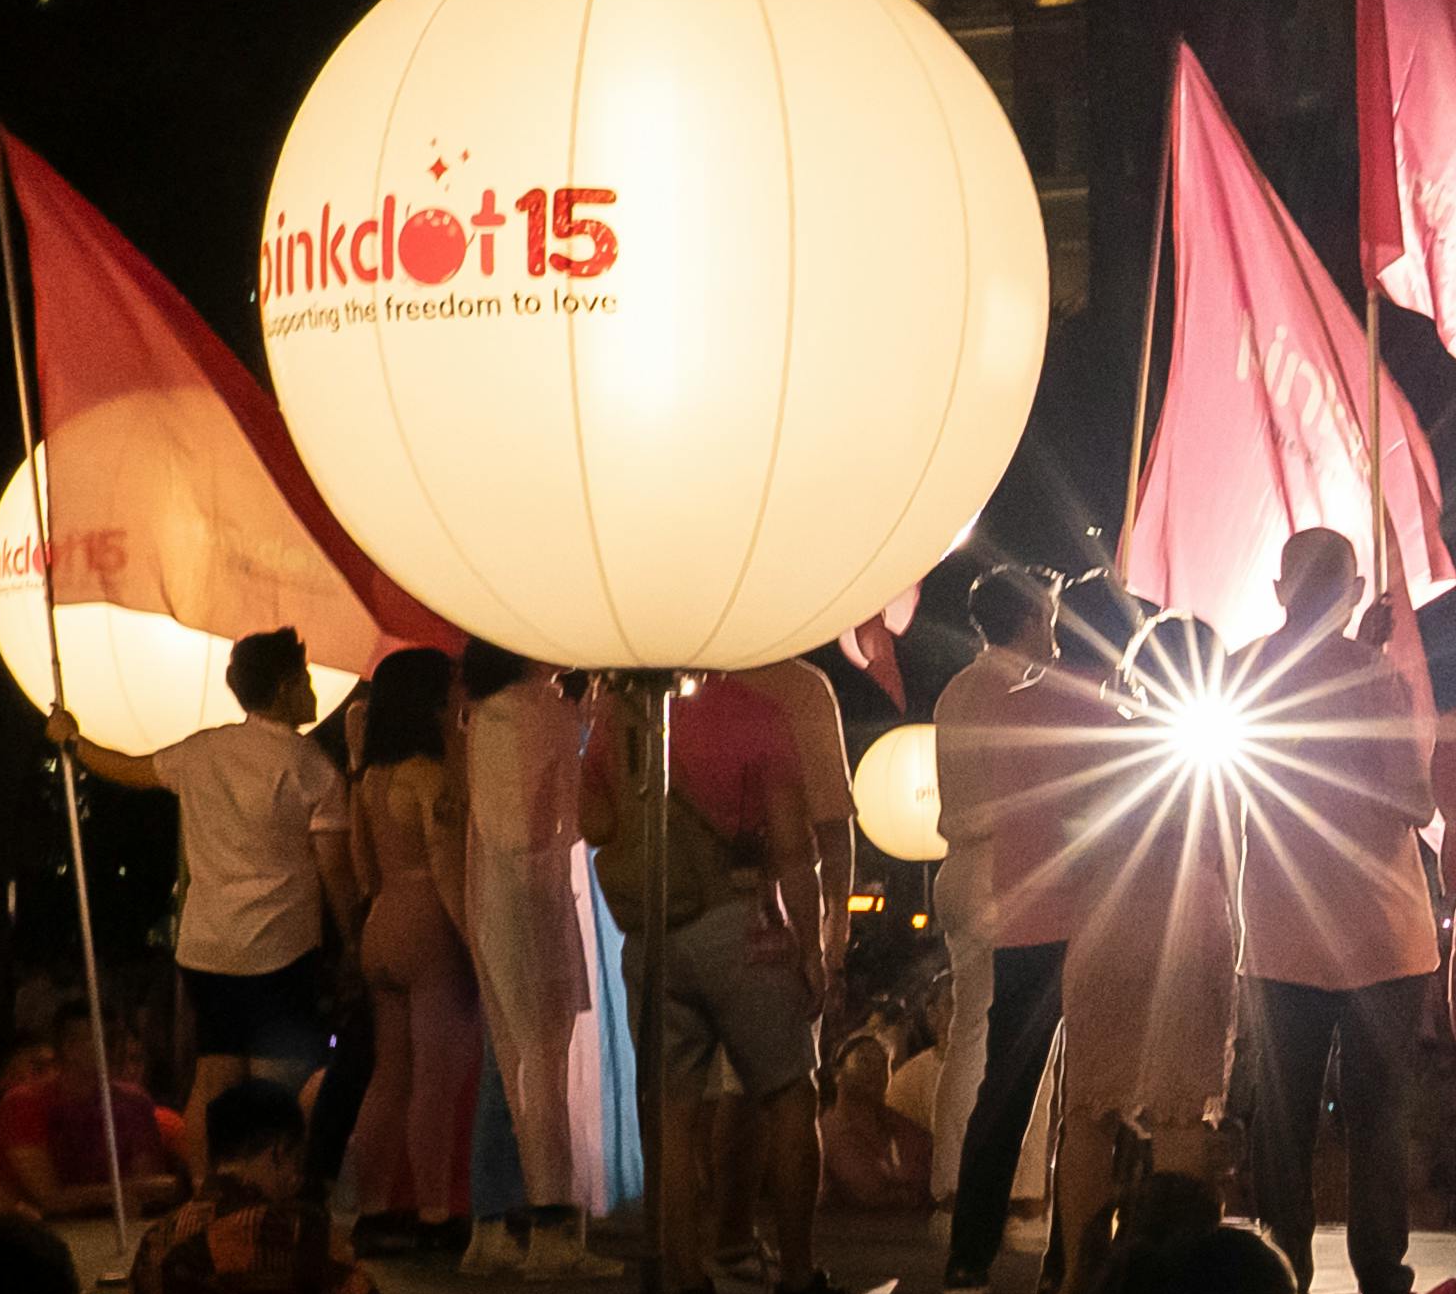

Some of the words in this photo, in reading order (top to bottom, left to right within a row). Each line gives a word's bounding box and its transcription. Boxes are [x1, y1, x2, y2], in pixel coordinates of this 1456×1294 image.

[514, 187, 619, 278] 15
[265, 302, 340, 339] upporting
[344, 297, 378, 325] the
[385, 292, 502, 323] freedom
[513, 290, 542, 315] to
[553, 287, 617, 315] love
